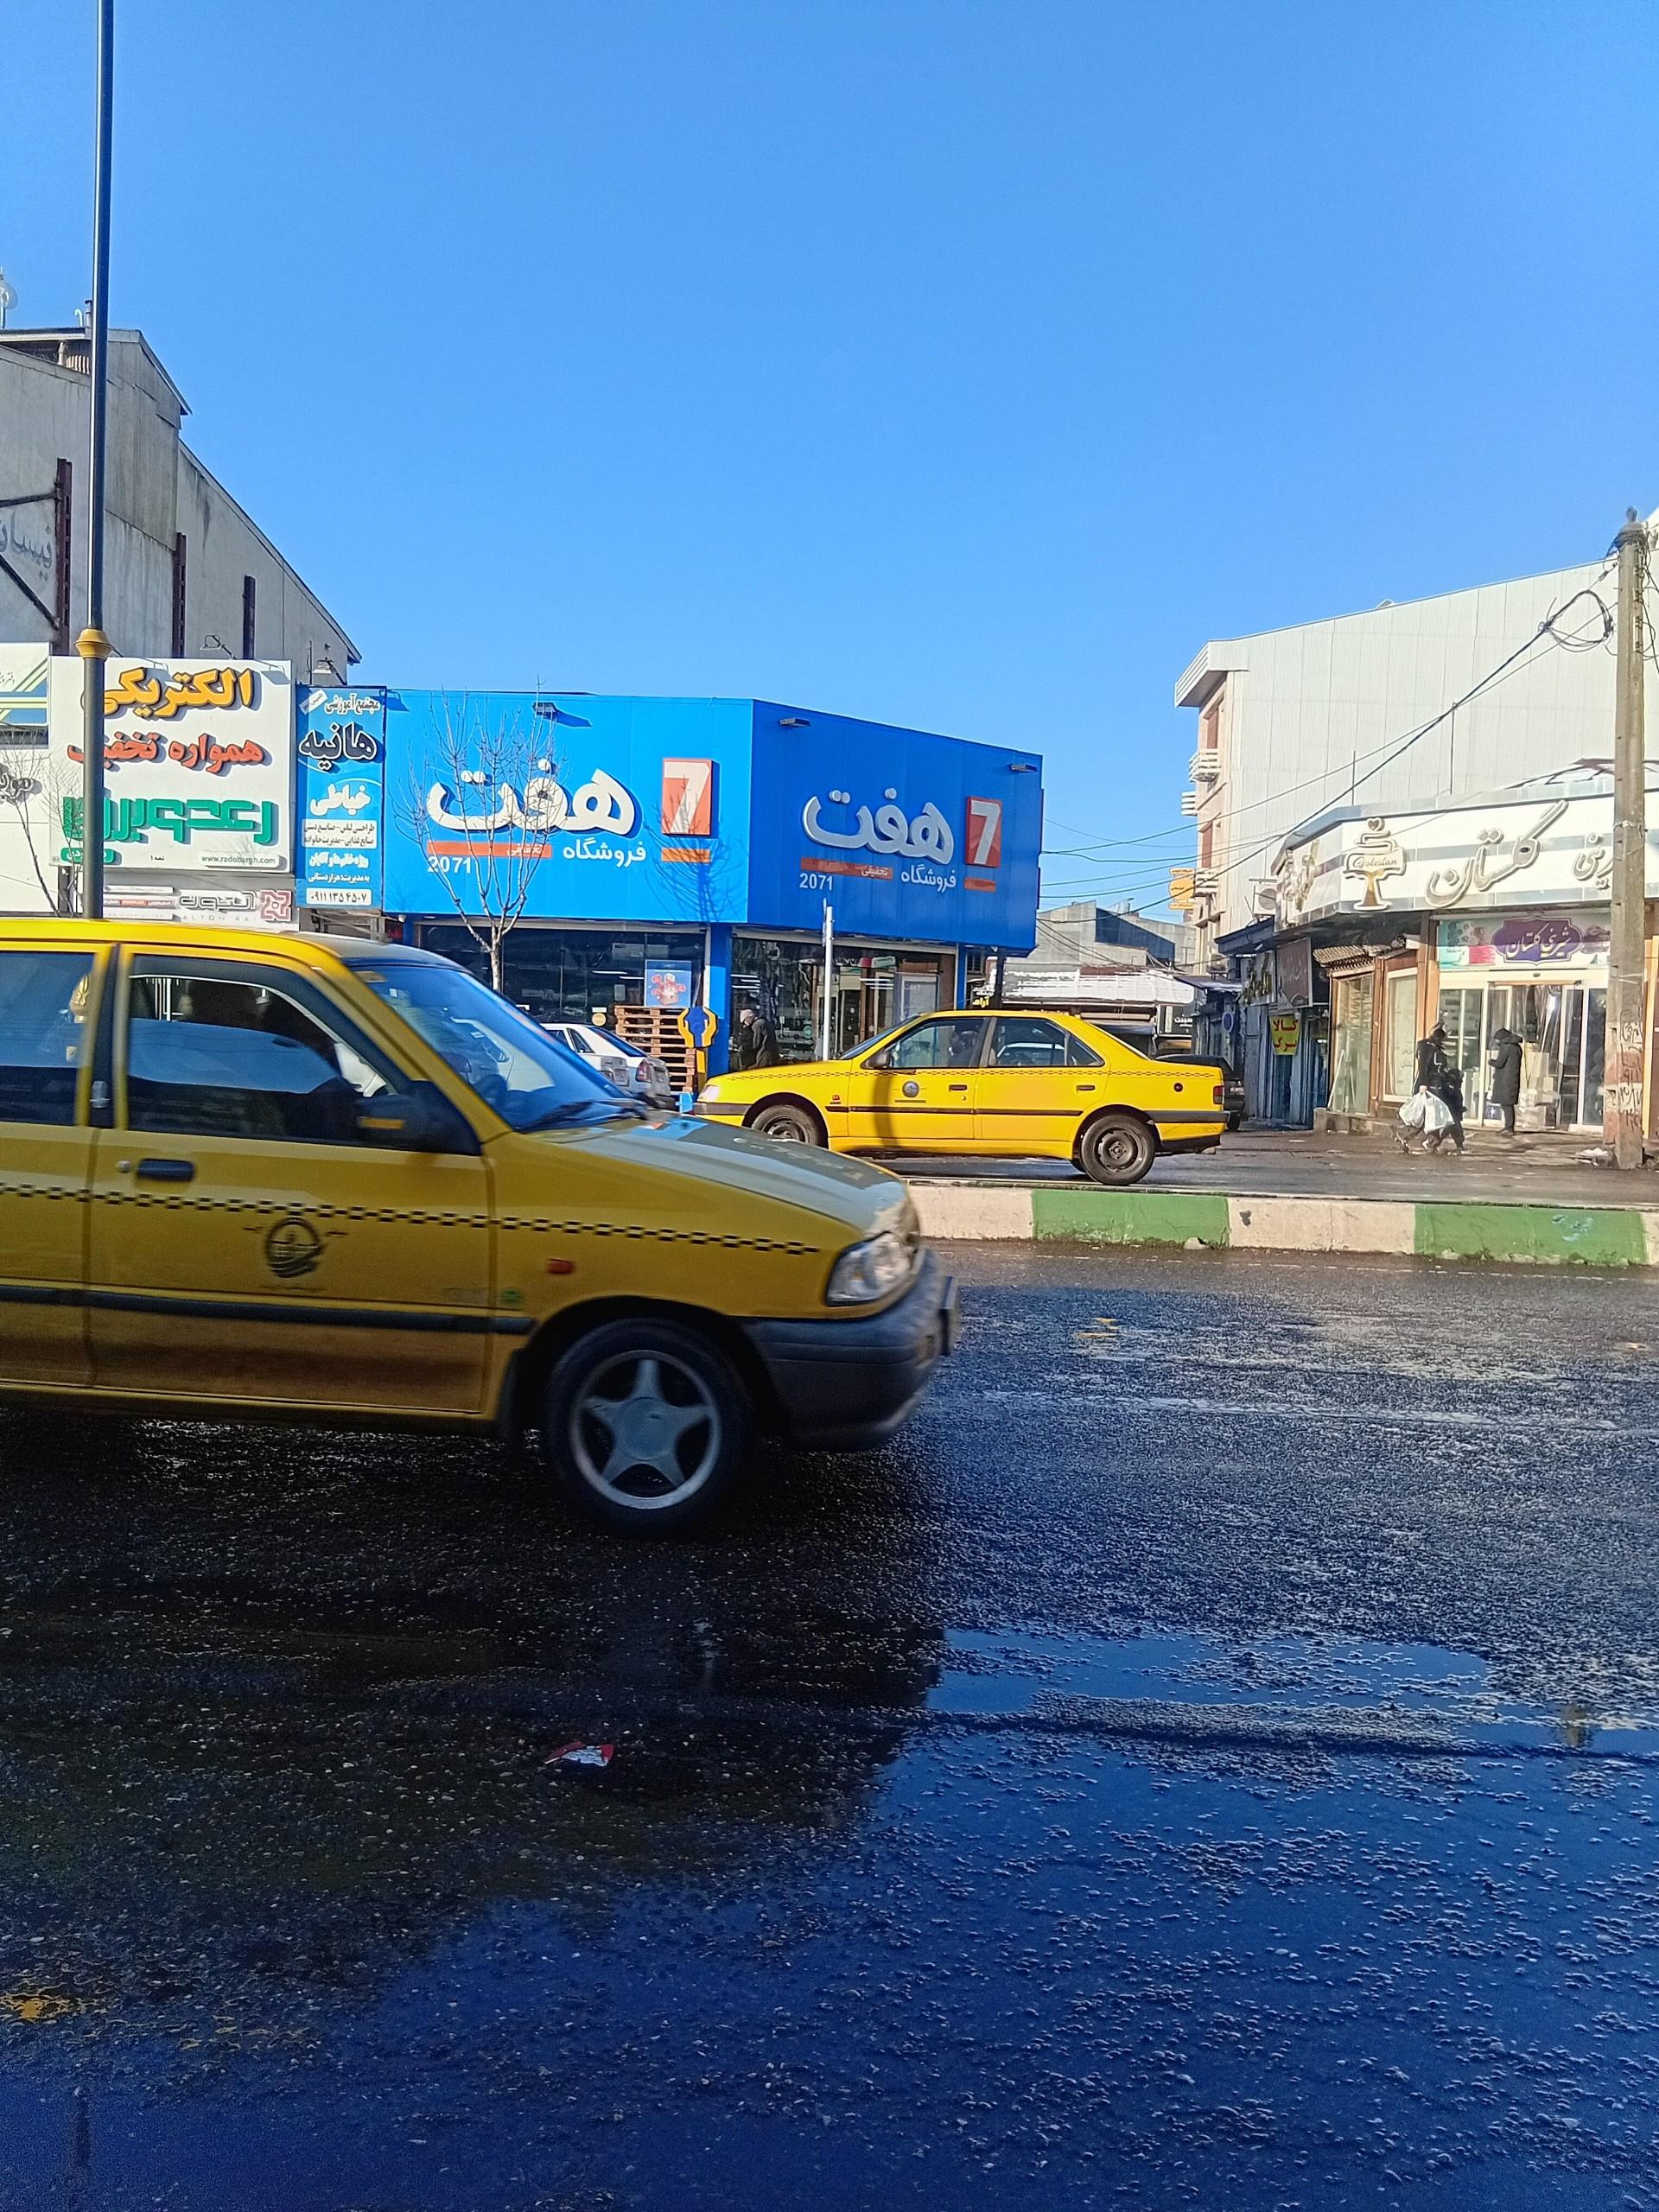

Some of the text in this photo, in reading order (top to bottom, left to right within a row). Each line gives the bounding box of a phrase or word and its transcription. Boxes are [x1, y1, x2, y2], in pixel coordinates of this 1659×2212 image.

[168, 733, 264, 773] همواره
[299, 721, 377, 770] هانیه
[310, 784, 372, 816] خیاطی
[426, 759, 635, 836] هفت
[664, 761, 710, 835] 7
[803, 787, 954, 865] هفت
[970, 799, 1001, 864] 7
[201, 855, 276, 865] www.radobargh.com
[427, 856, 473, 874] 2071
[563, 837, 646, 868] فروشگاه
[1352, 856, 1397, 868] Golestan
[1425, 800, 1568, 908] گلستان
[799, 873, 833, 891] 2071
[900, 865, 957, 892] فروشگاه
